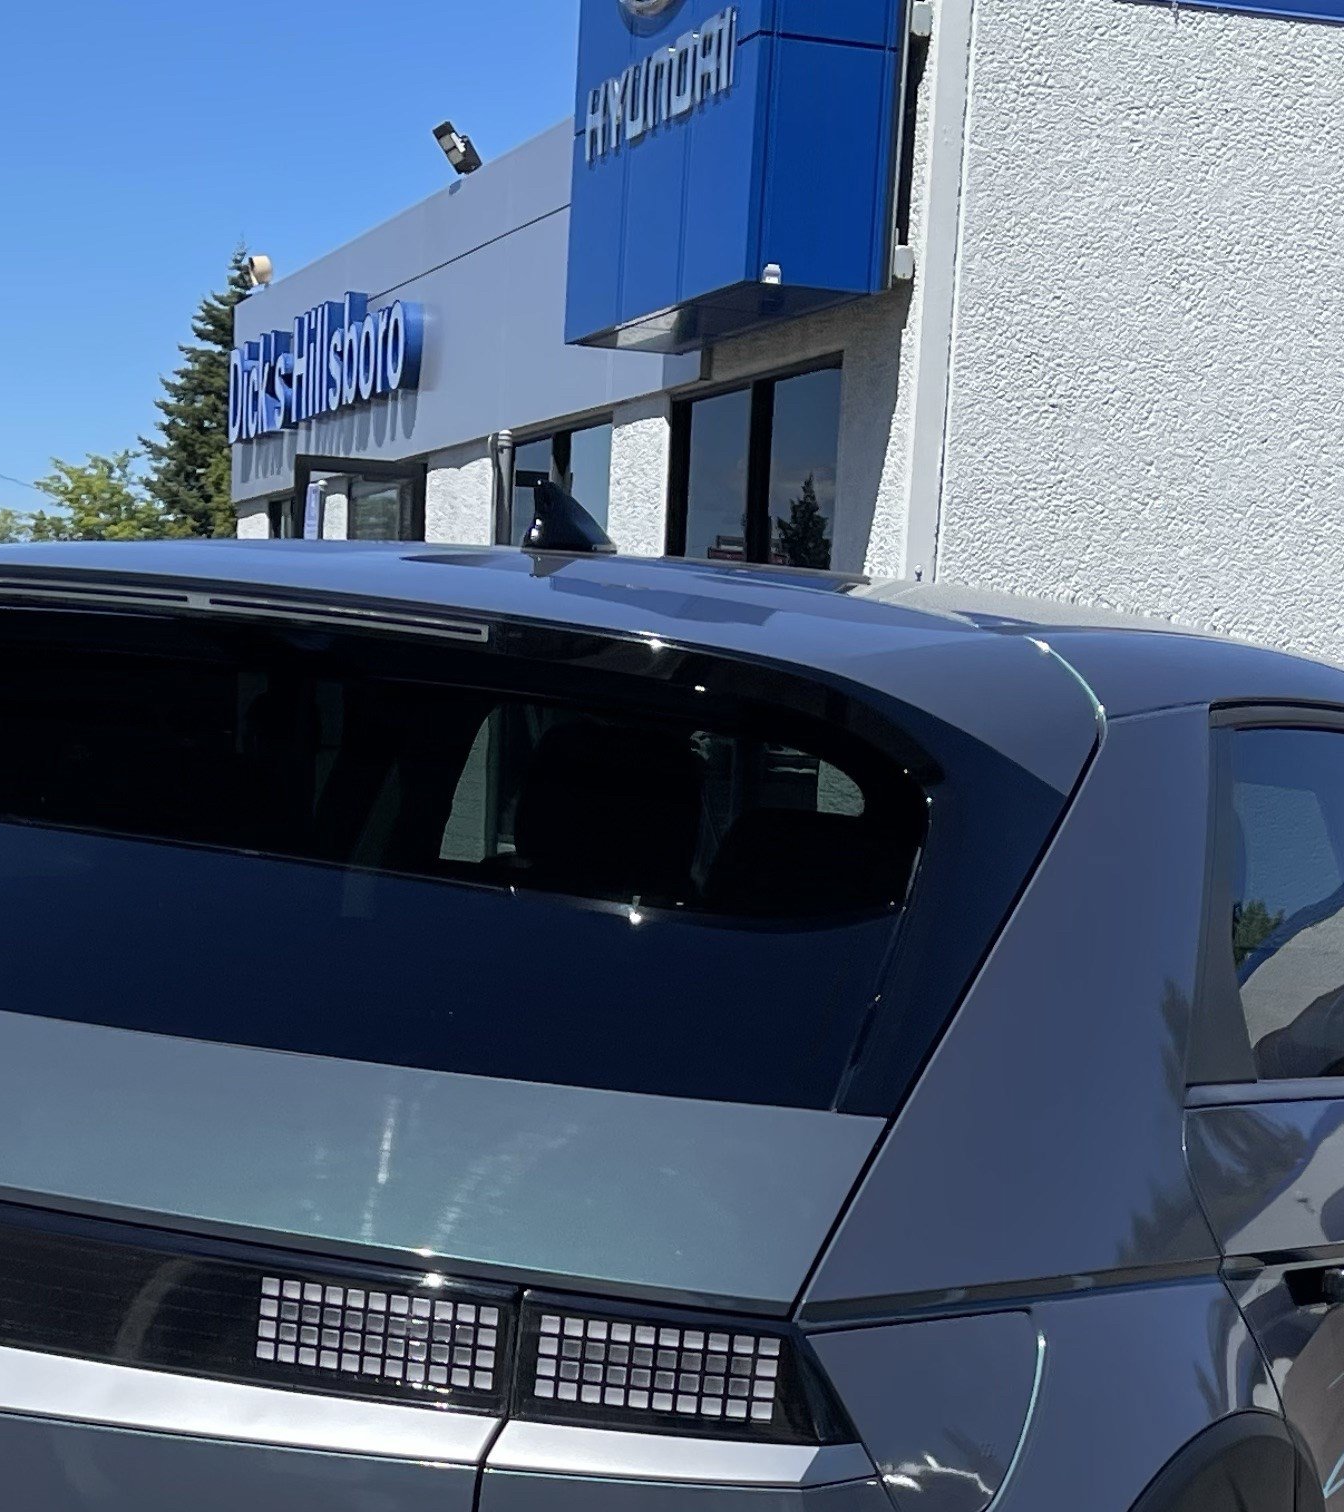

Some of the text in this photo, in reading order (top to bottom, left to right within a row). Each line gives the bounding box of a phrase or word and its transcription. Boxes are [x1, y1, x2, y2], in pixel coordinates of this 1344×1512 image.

[585, 6, 737, 164] HYUNDAI
[229, 291, 409, 444] Dick's Hillsboro
